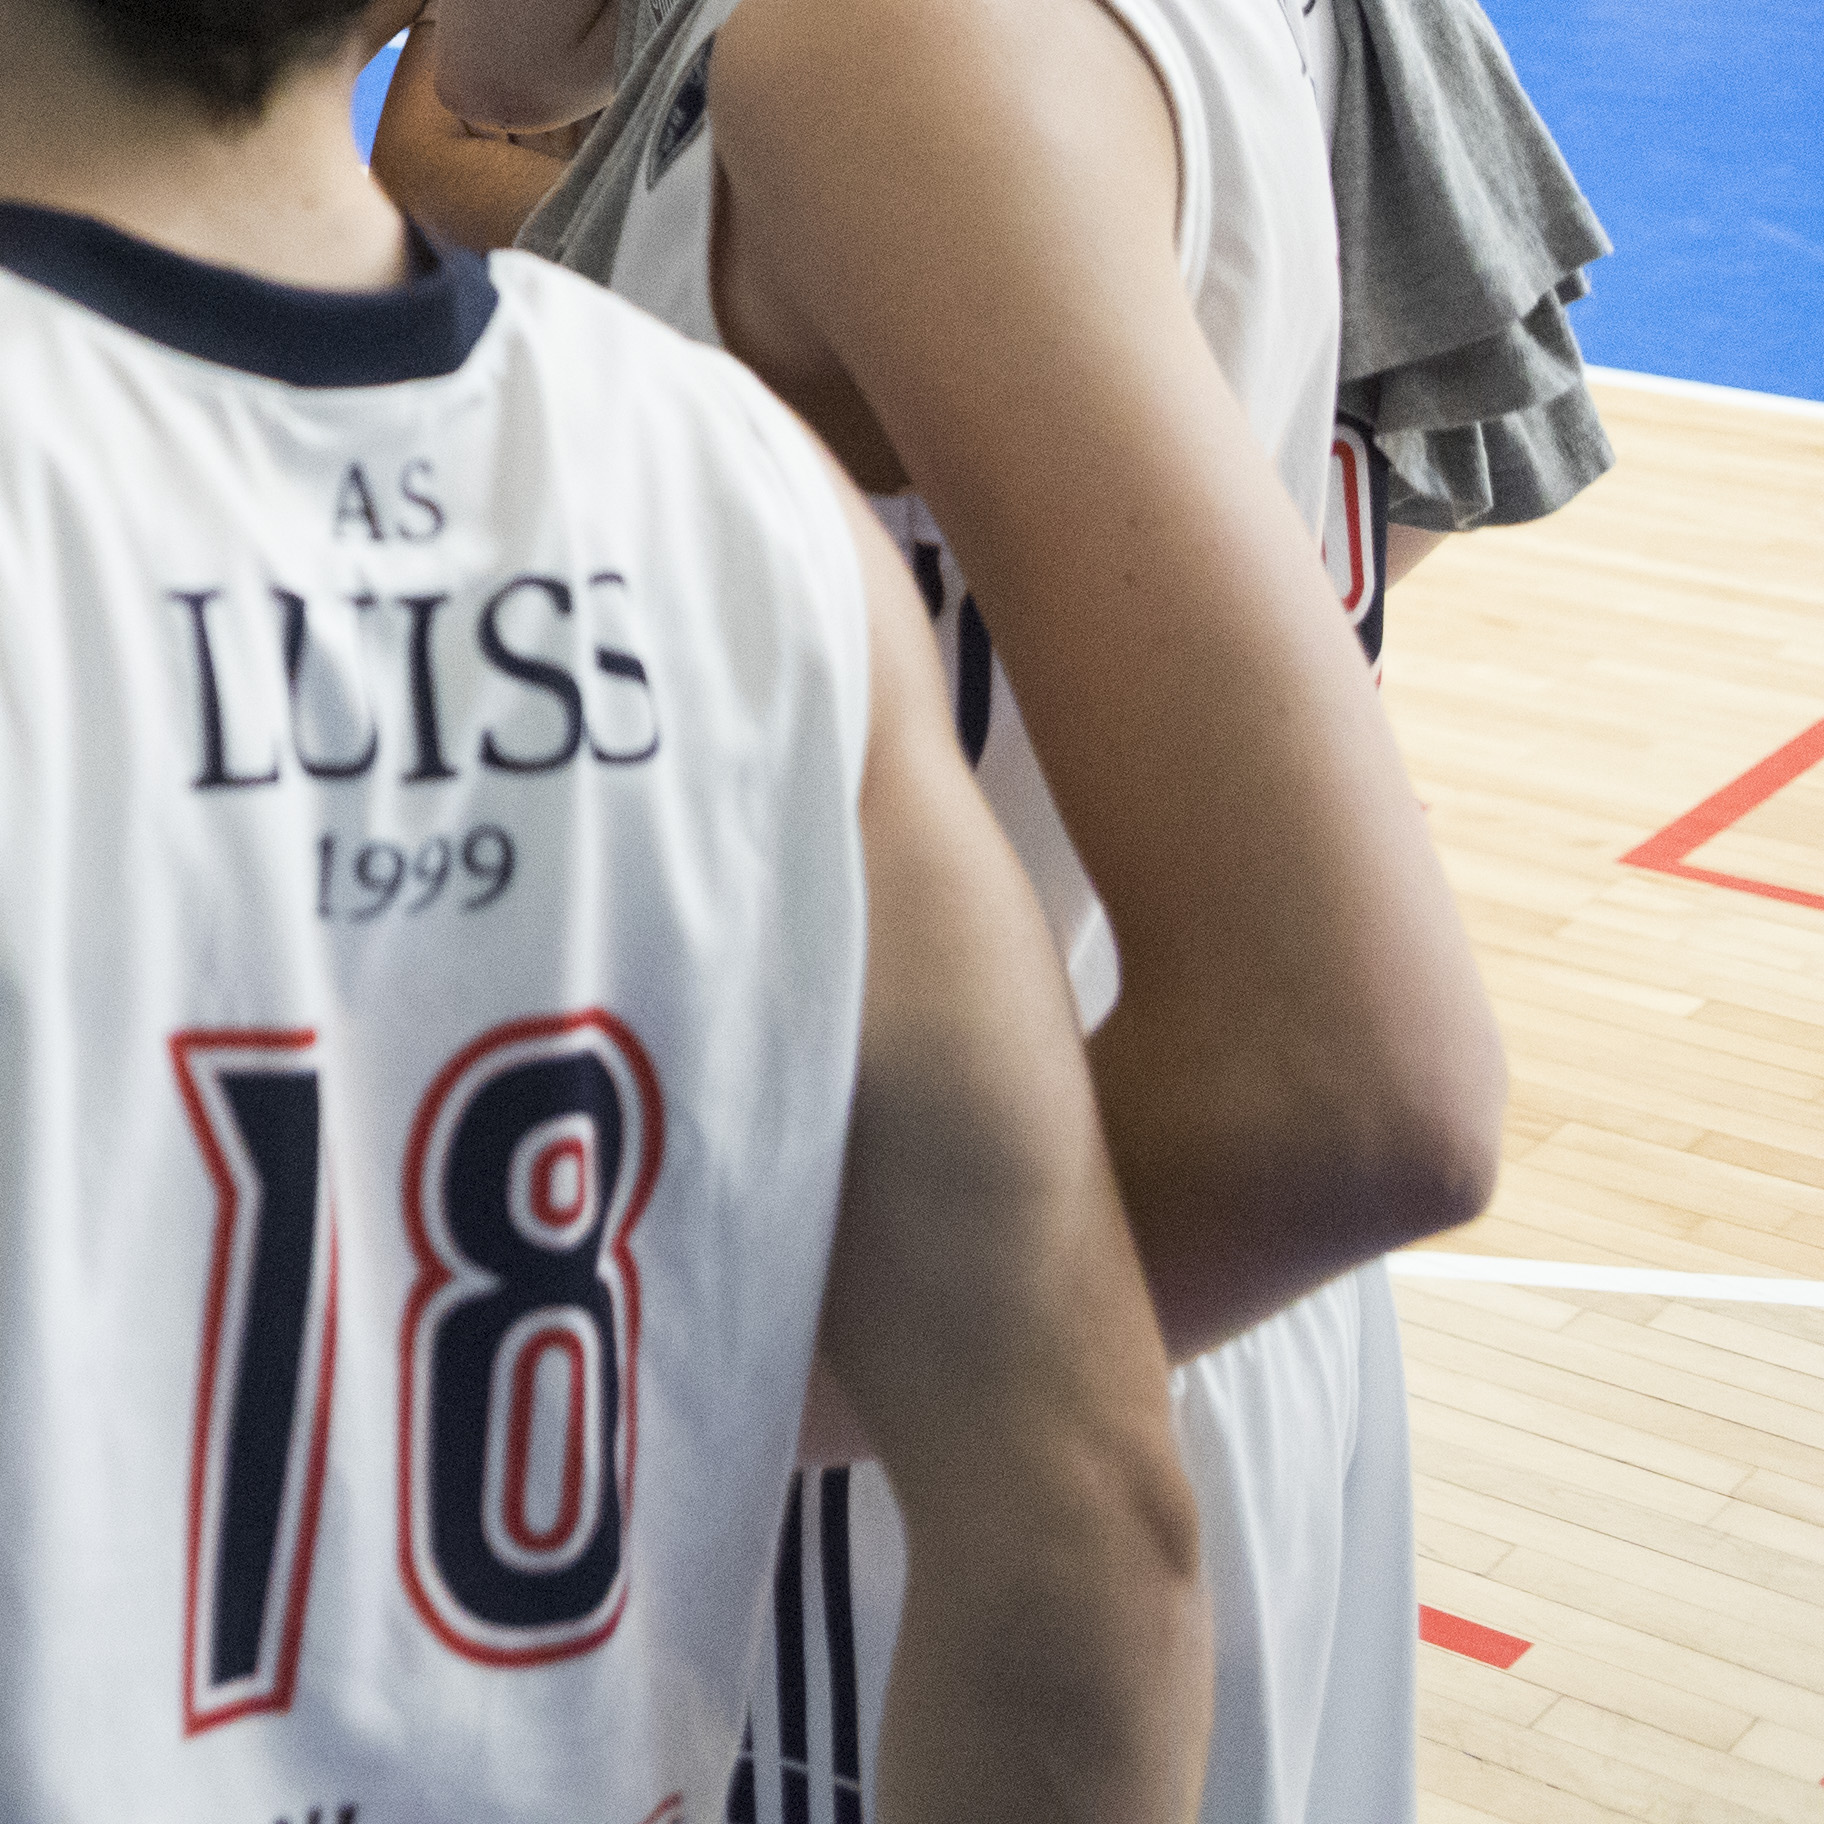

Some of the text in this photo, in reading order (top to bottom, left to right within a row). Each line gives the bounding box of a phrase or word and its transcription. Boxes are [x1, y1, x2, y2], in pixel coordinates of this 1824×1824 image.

[332, 457, 449, 545] AS
[316, 822, 519, 926] 1999
[167, 1007, 667, 1740] 18
